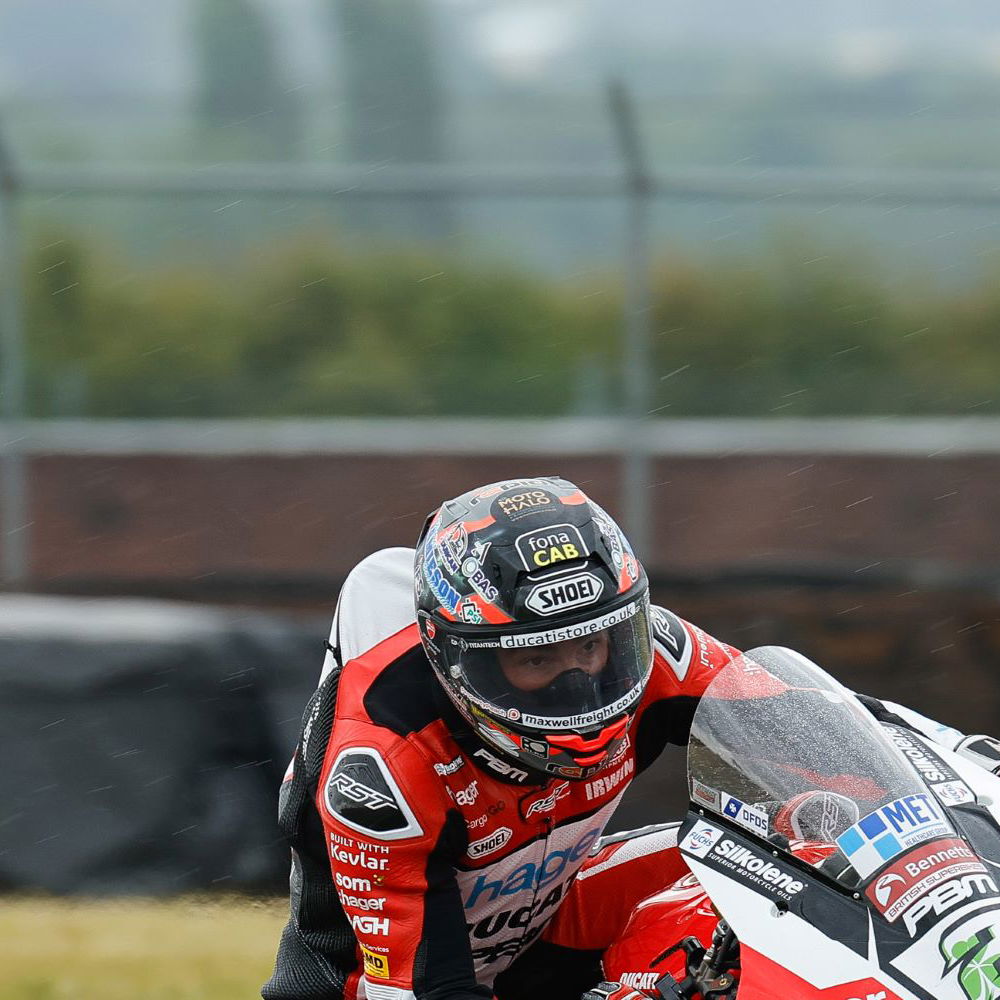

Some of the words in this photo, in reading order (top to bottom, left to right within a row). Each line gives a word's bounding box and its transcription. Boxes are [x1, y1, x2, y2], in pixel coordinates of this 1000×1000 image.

[498, 491, 546, 508] MOTO
[503, 497, 551, 515] HALO
[528, 532, 570, 551] fona
[533, 543, 579, 566] CAB
[538, 579, 594, 609] SHOEI
[505, 606, 633, 648] ducatistore.co.uk
[525, 687, 640, 728] maxwellfreight.co.uk
[329, 772, 398, 810] RST
[585, 758, 634, 800] IRWIN
[881, 794, 939, 833] MET
[330, 832, 353, 847] BUILT
[357, 841, 389, 854] WITH
[473, 833, 505, 855] SHOEI
[689, 831, 714, 847] FUCHS
[707, 852, 736, 871] SUPERIOR
[737, 866, 777, 896] MOTORCYCLE
[776, 890, 793, 902] OILS
[715, 840, 805, 895] Silkolene
[905, 846, 974, 878] Bennetts
[336, 872, 371, 892] som
[888, 883, 926, 918] BRITISH
[902, 874, 999, 938] PBM
[619, 972, 660, 990] DUCATI
